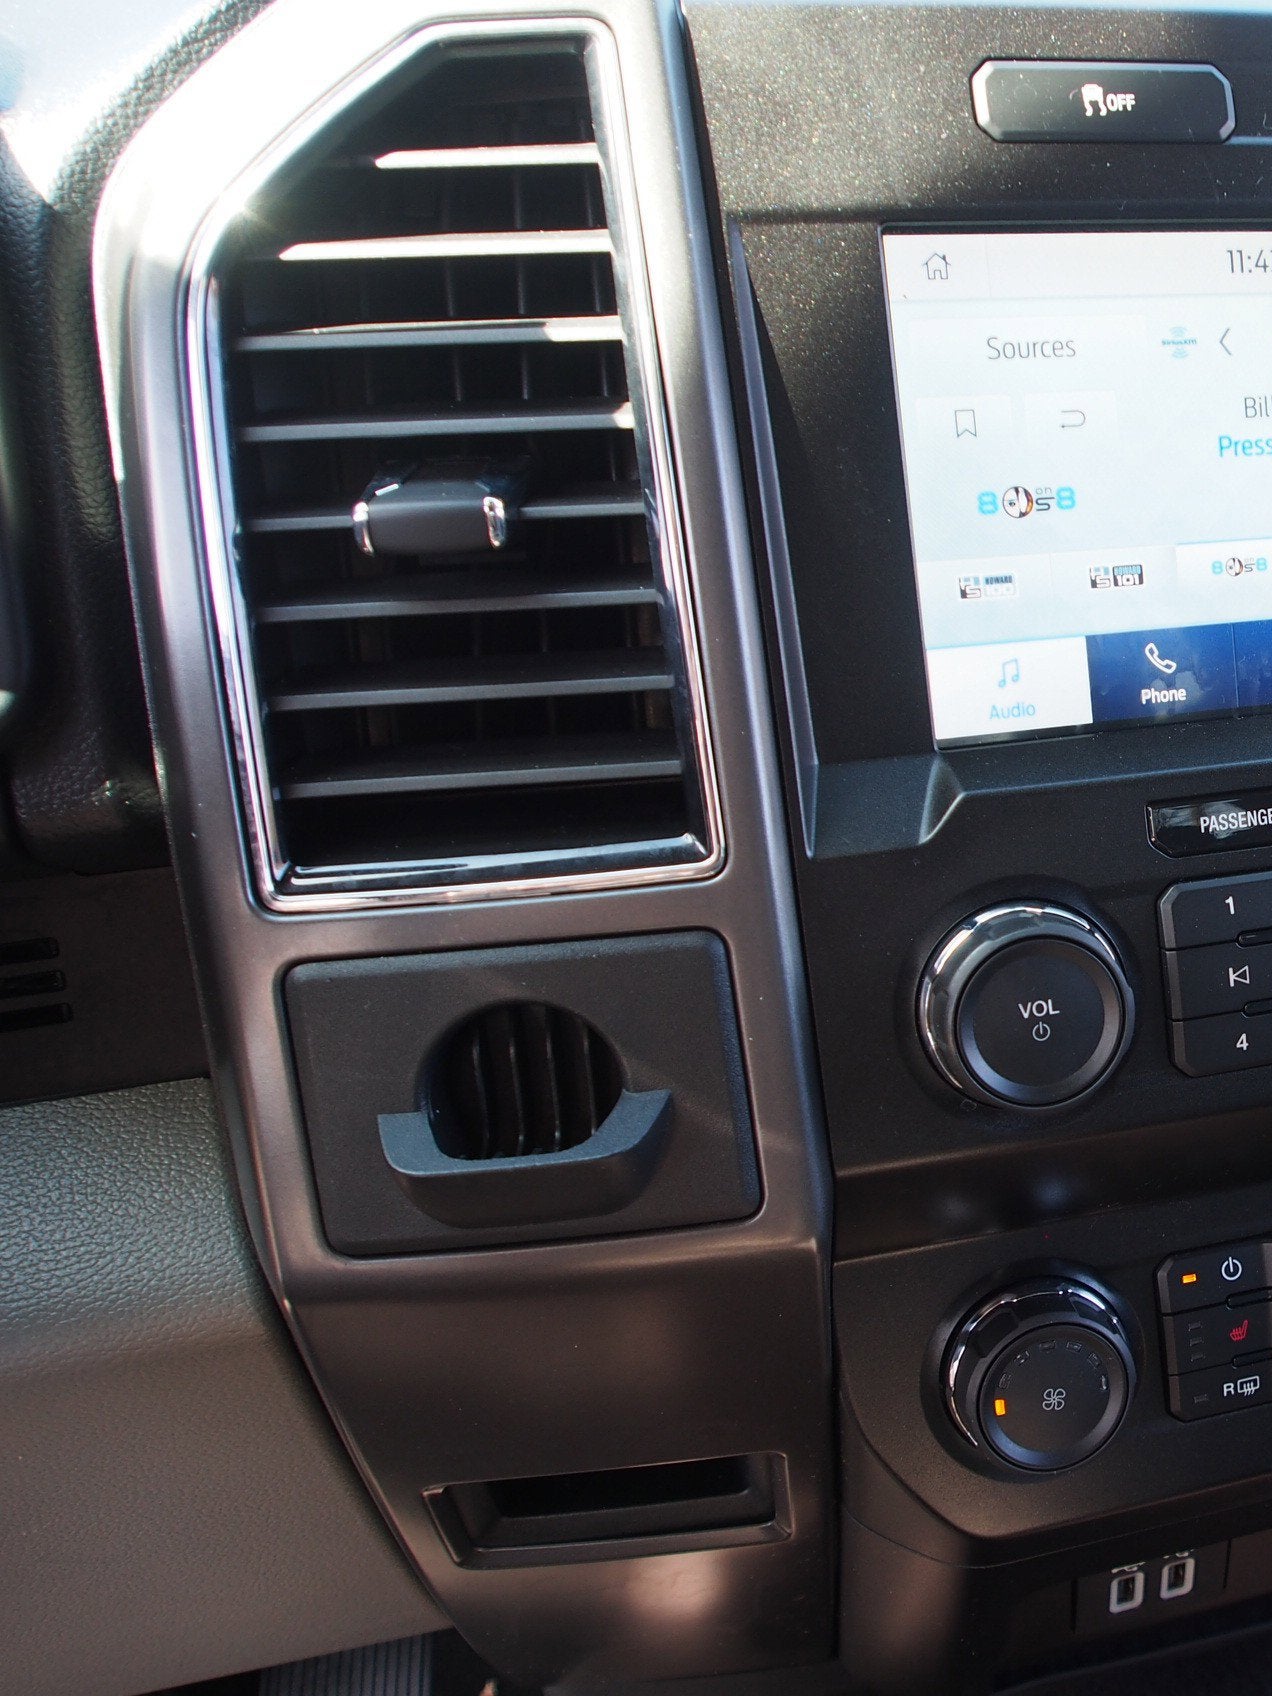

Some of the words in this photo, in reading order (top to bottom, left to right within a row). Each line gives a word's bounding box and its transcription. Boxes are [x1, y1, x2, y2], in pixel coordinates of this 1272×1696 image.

[1105, 93, 1136, 112] OFF
[987, 337, 1077, 361] Sources
[1141, 687, 1187, 705] Phone
[989, 701, 1036, 721] Audio
[1224, 896, 1236, 916] 1
[1018, 999, 1061, 1019] VOL
[1236, 1033, 1249, 1052] 4
[1223, 1382, 1235, 1397] R
